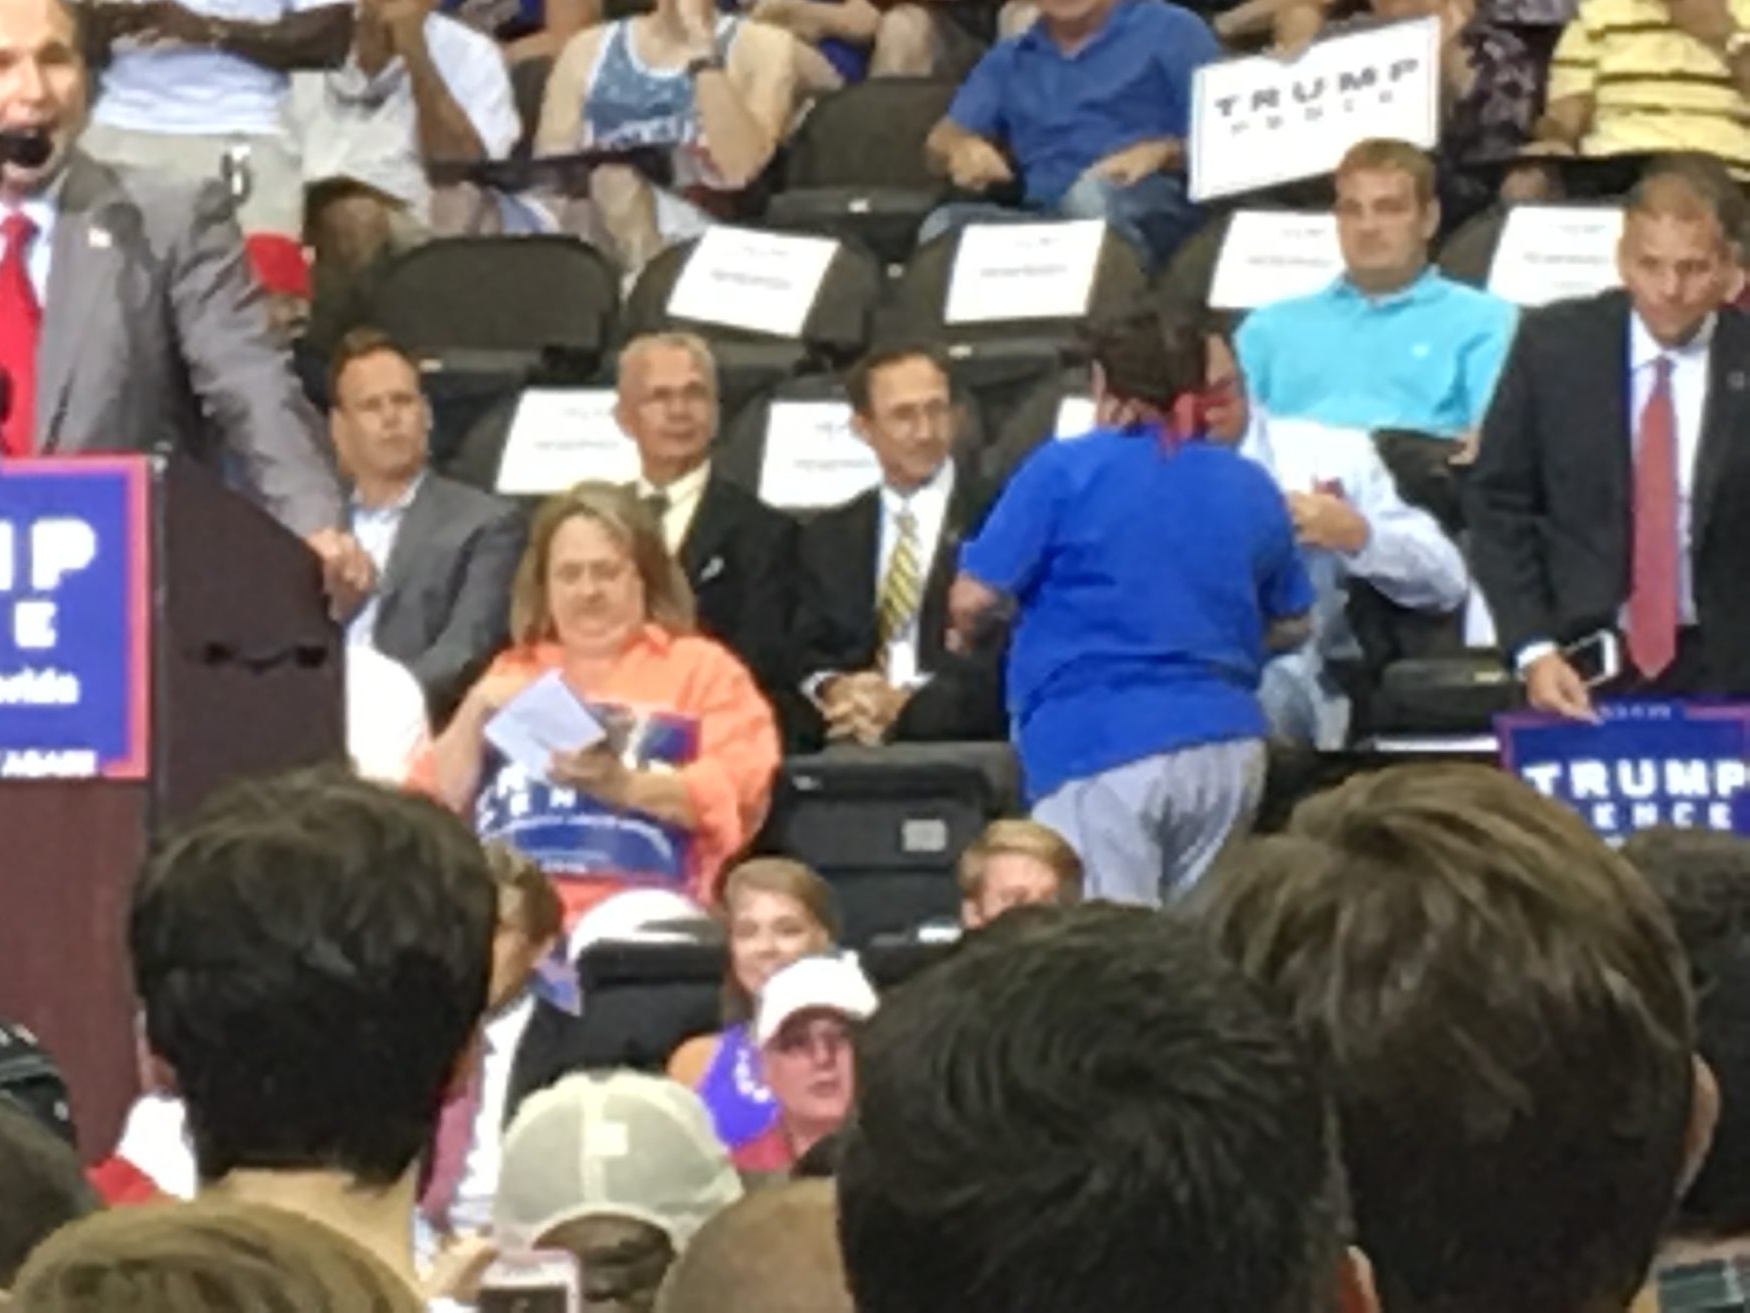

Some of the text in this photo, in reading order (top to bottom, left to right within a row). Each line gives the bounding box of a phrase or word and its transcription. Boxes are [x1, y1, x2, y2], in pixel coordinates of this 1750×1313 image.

[1215, 58, 1419, 117] TRUMP
[1522, 758, 1746, 799] TRUMP
[1591, 801, 1733, 830] ENCE
